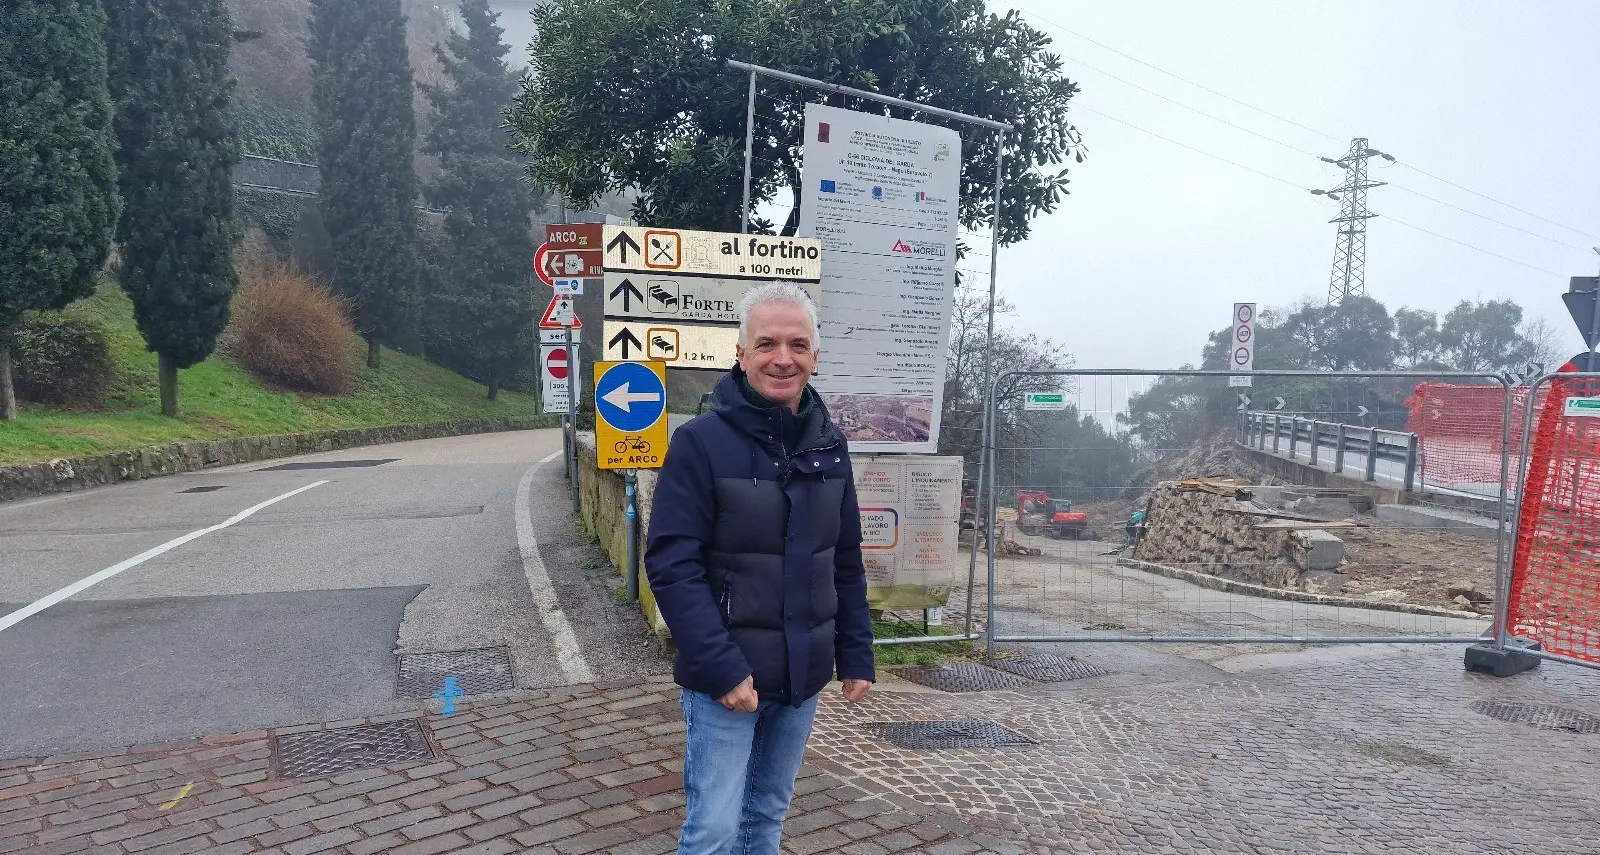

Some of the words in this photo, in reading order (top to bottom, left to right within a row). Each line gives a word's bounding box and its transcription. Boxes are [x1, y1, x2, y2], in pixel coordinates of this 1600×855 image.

[549, 231, 577, 243] ARCO
[721, 237, 740, 255] al
[748, 238, 819, 260] fortino
[913, 246, 946, 257] MORELLI
[739, 265, 746, 273] a
[750, 264, 771, 274] 100
[775, 266, 803, 276] metri
[684, 352, 697, 360] 1.2
[700, 352, 715, 361] km
[607, 456, 623, 465] per
[628, 455, 658, 464] ARCO
